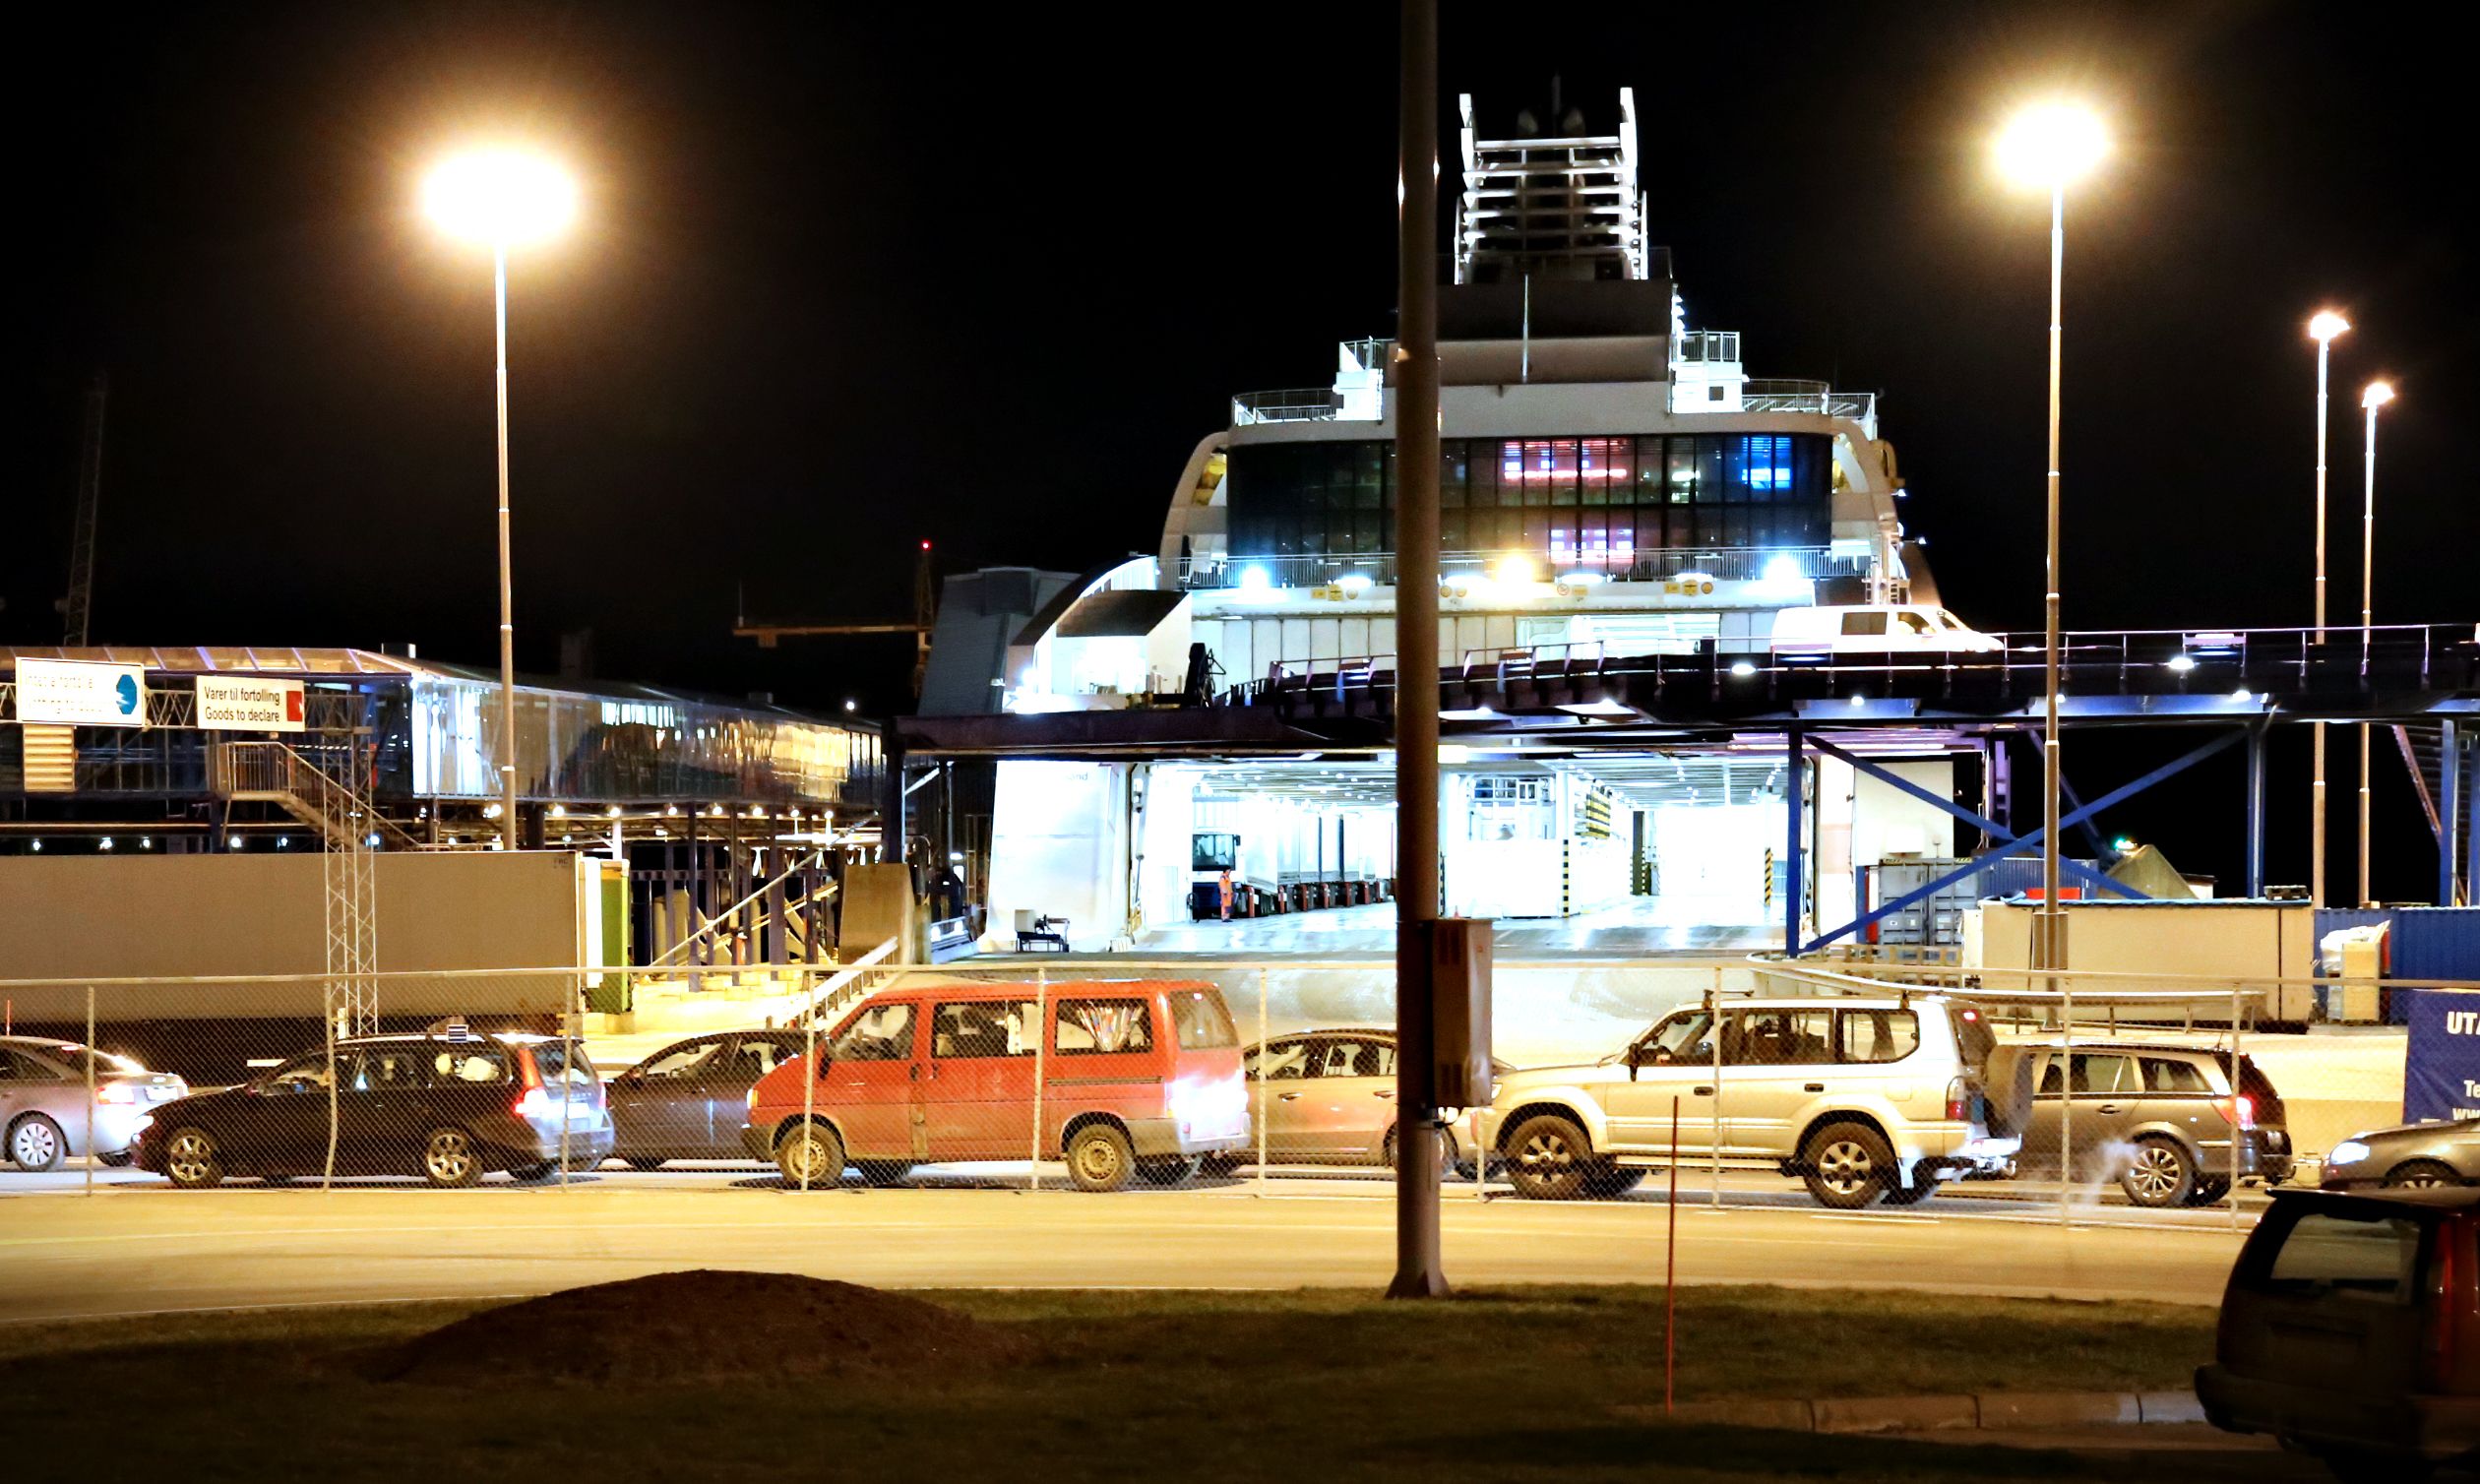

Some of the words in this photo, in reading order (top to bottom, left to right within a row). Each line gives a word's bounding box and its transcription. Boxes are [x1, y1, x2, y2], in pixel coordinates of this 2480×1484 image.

[205, 686, 227, 700] Varer
[205, 706, 234, 720] Goods
[236, 709, 246, 720] to
[248, 709, 279, 721] declare
